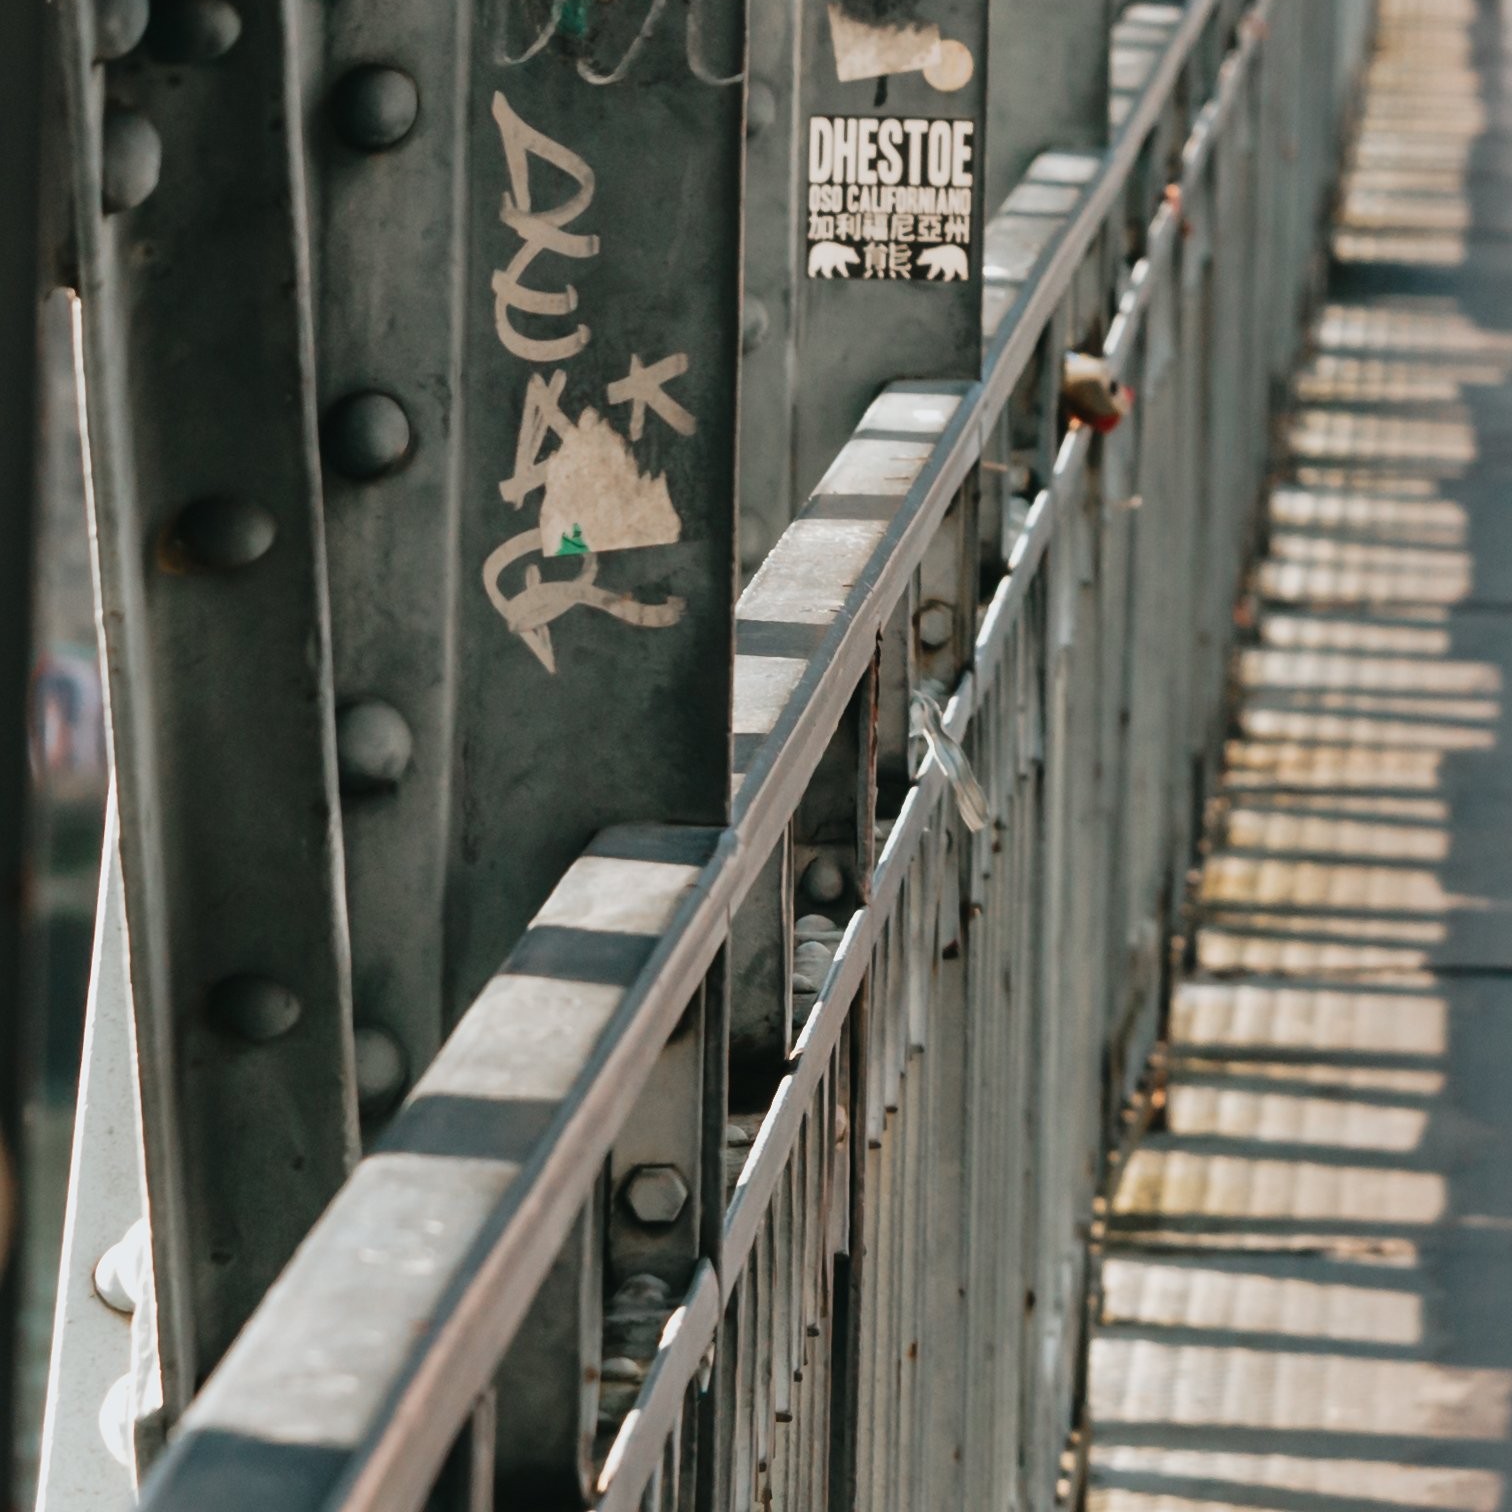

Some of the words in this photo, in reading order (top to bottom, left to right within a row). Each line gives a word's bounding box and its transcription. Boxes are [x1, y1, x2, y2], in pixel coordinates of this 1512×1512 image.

[808, 116, 974, 187] DHESTOE
[808, 185, 843, 213] OSO
[846, 185, 972, 215] CALIFORNIANO
